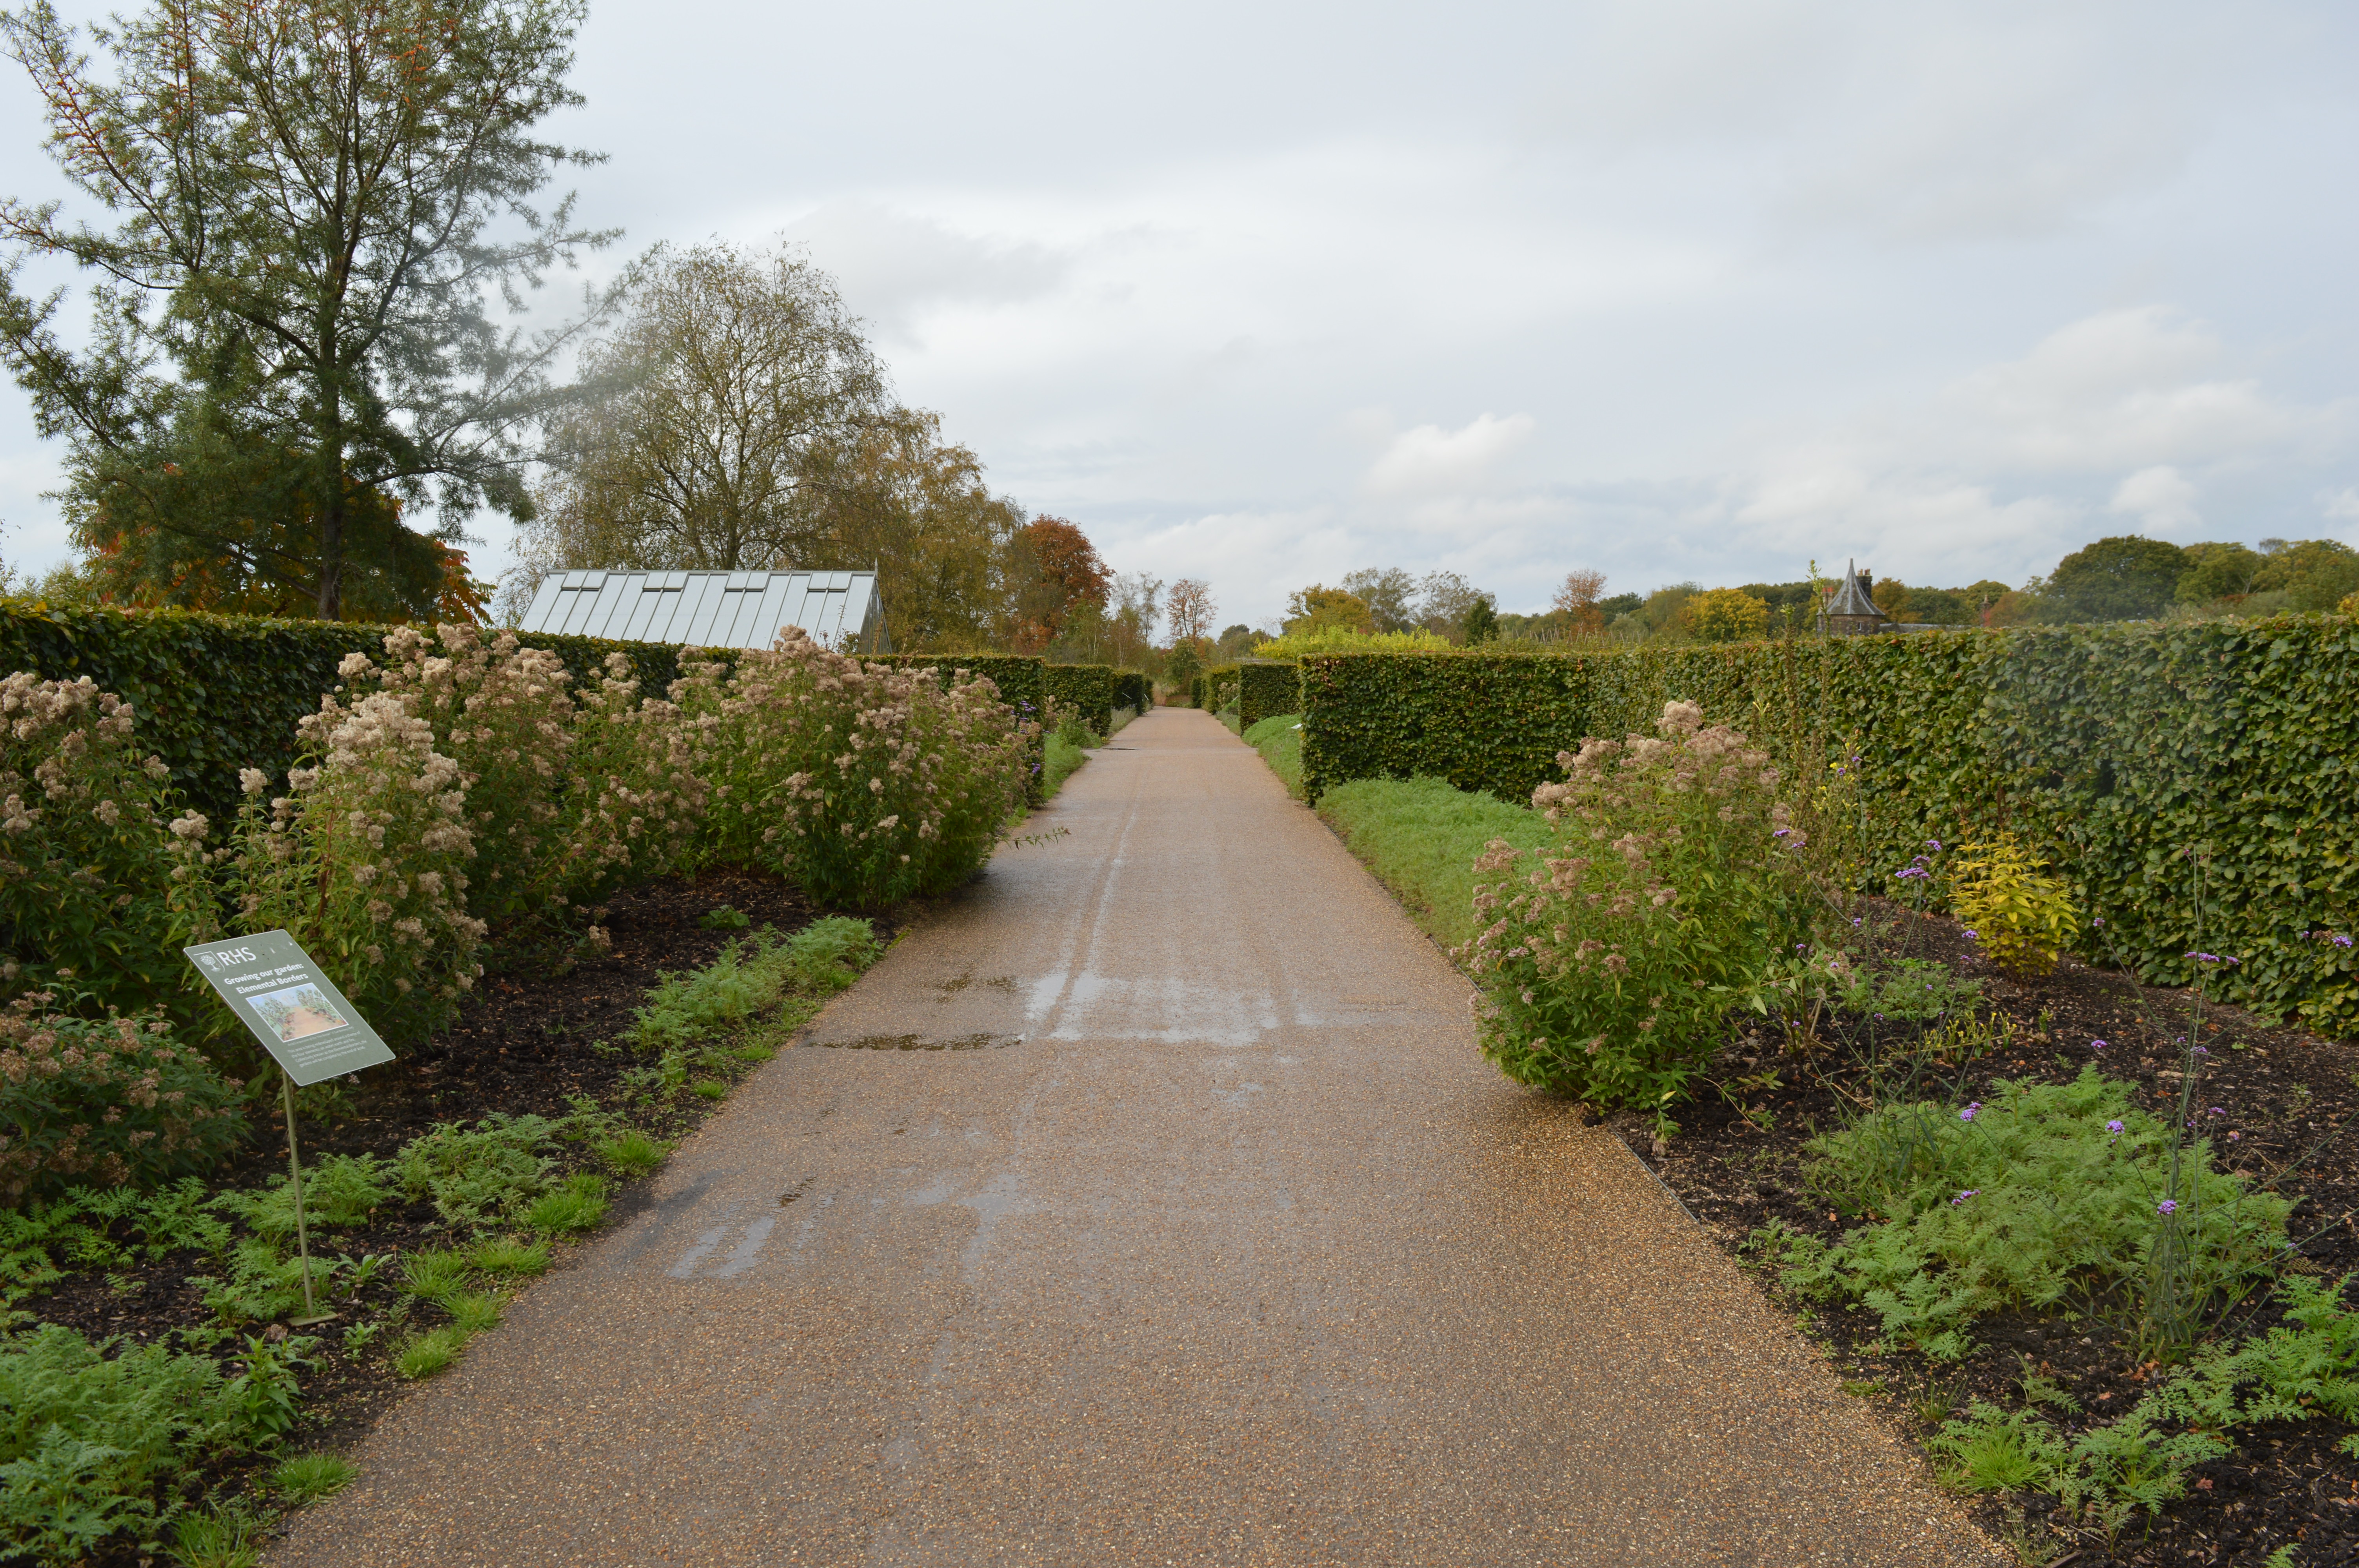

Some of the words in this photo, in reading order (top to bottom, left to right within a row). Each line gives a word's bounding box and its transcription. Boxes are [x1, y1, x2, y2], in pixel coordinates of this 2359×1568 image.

[216, 947, 256, 966] RHS
[224, 974, 261, 985] Growing
[274, 964, 304, 976] garden:
[236, 979, 278, 994] Elemental
[276, 973, 309, 984] Borders
